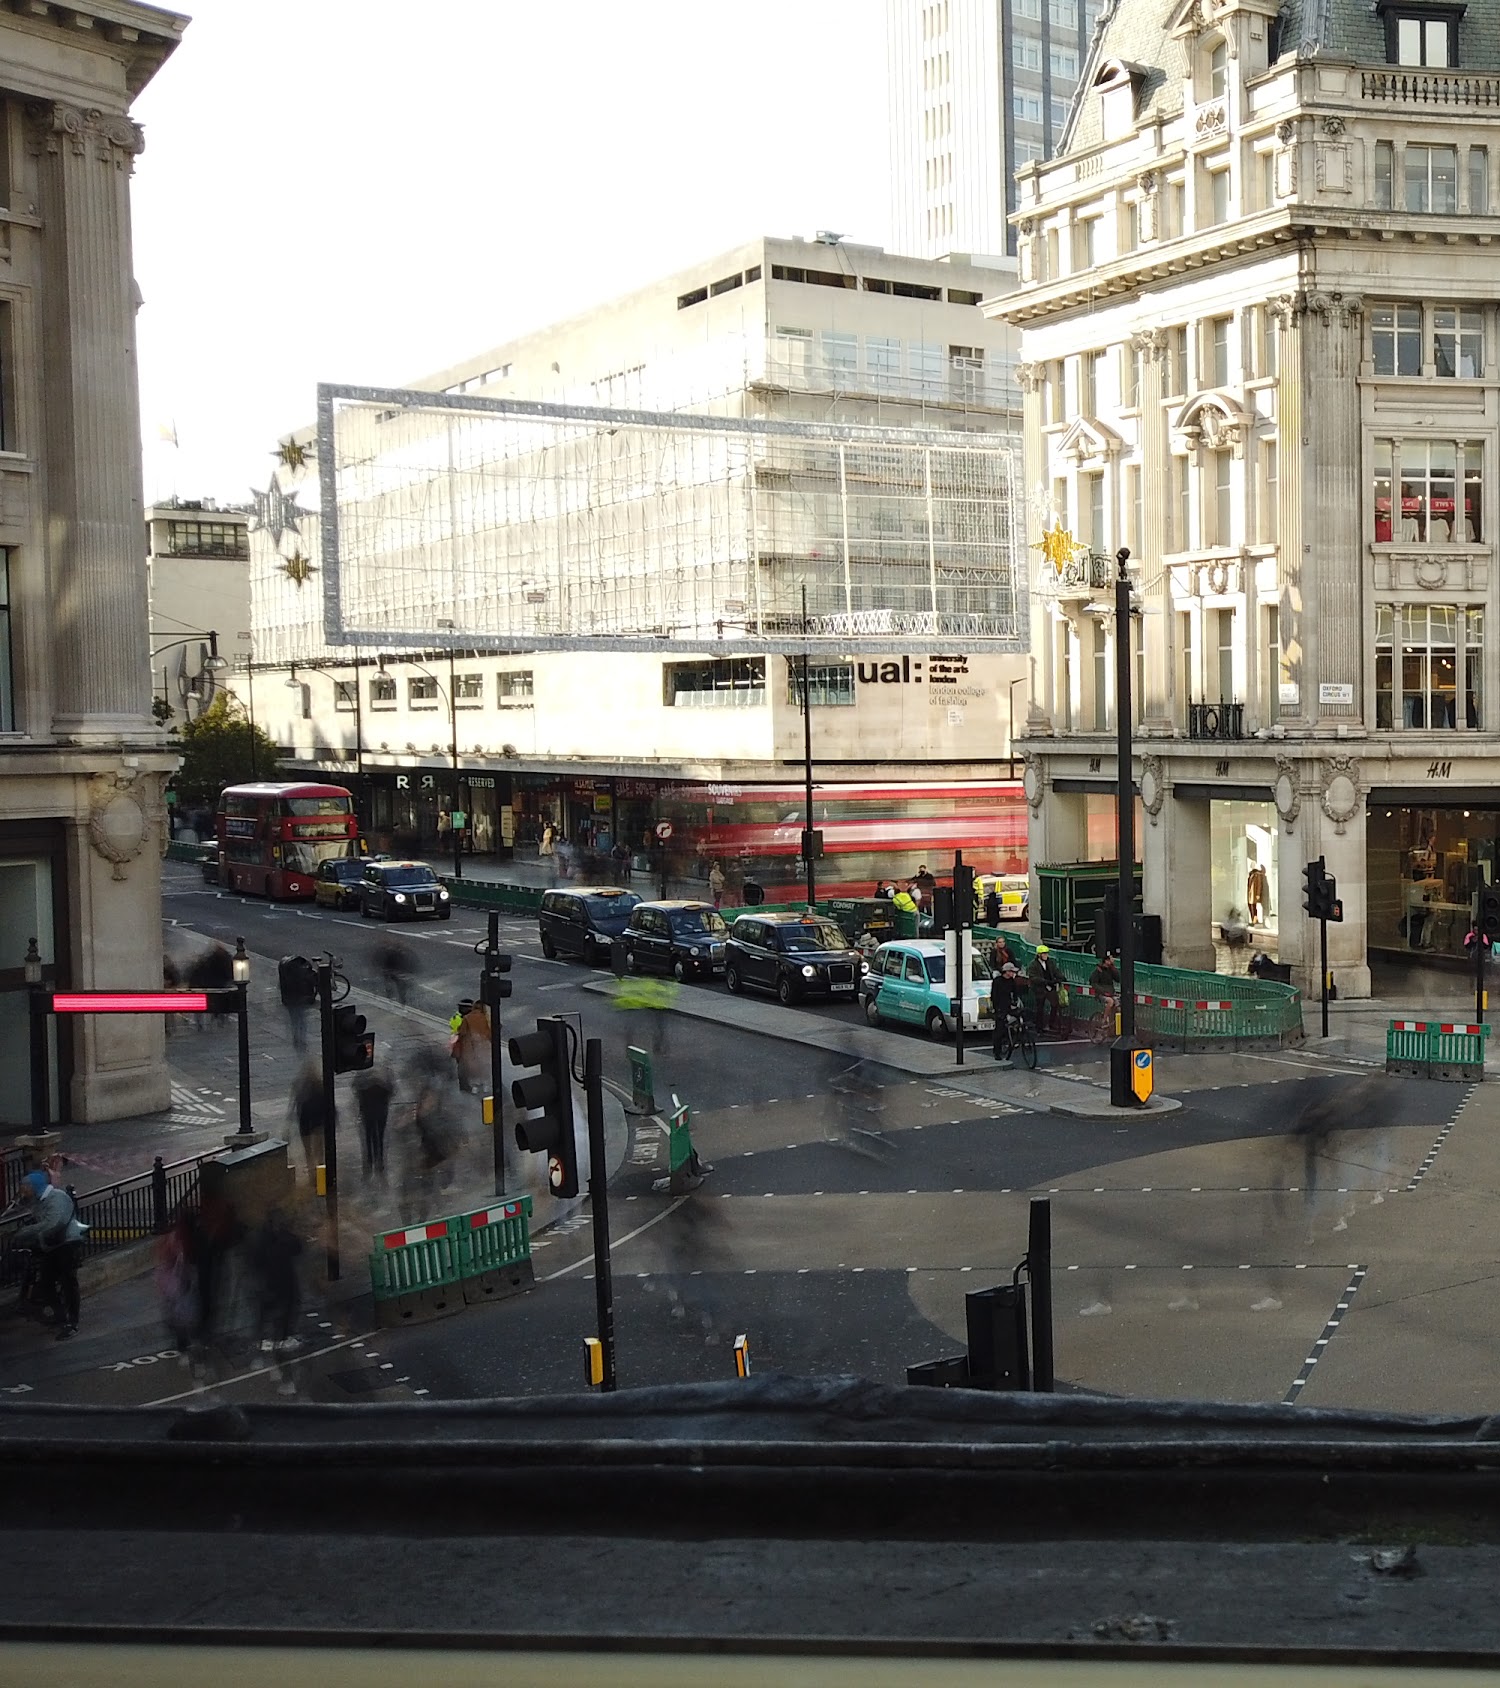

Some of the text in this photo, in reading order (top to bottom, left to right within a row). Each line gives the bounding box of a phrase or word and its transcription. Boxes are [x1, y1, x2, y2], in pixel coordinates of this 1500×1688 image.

[858, 655, 922, 683] ual:
[929, 664, 969, 673] of the arts
[929, 675, 957, 683] london
[929, 686, 986, 697] london college
[929, 697, 968, 706] of fashion
[1426, 761, 1452, 778] H&M
[397, 775, 409, 789] R
[468, 776, 495, 788] RESERVED
[708, 784, 742, 797] SOUVENIRS
[832, 901, 856, 909] CONWAY
[99, 1350, 181, 1373] OOK
